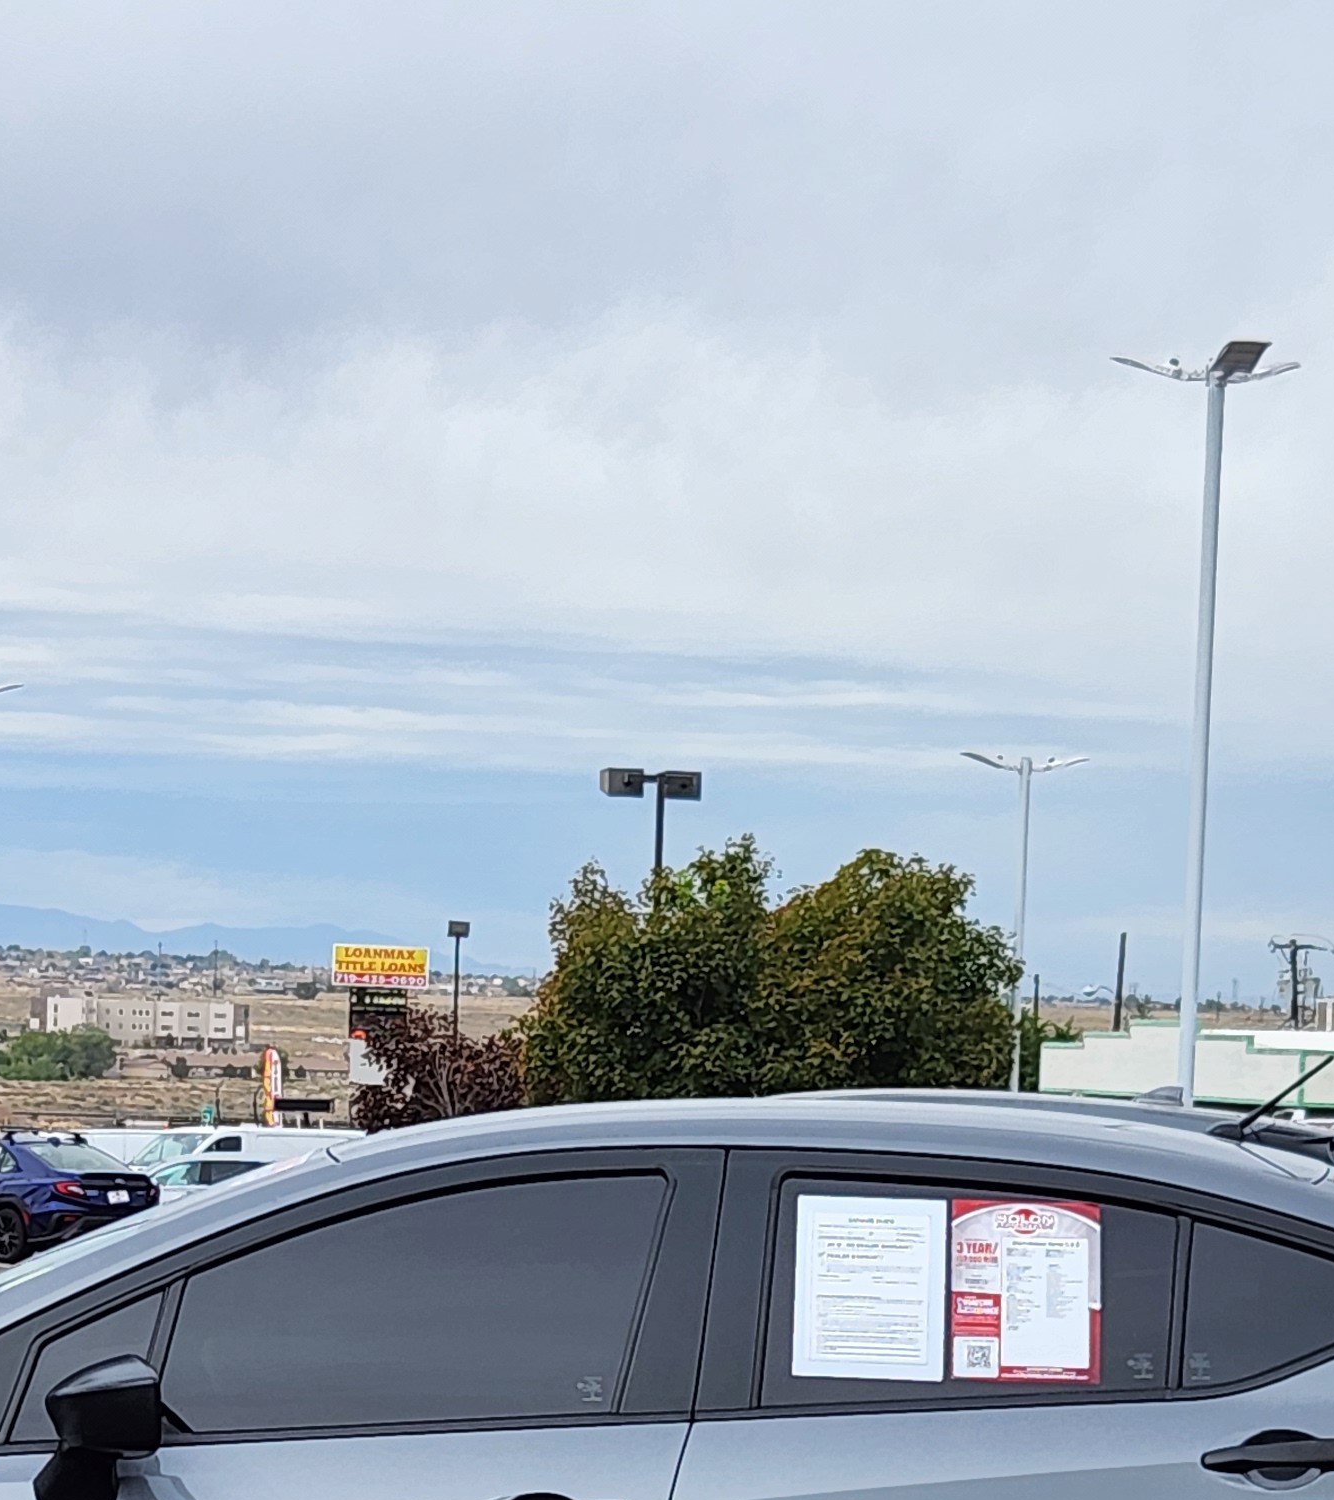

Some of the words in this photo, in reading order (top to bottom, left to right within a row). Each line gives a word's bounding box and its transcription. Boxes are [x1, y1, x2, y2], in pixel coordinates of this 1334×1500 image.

[344, 947, 416, 960] LOANMAX
[336, 960, 376, 971] TITLE
[381, 962, 425, 974] LOANS
